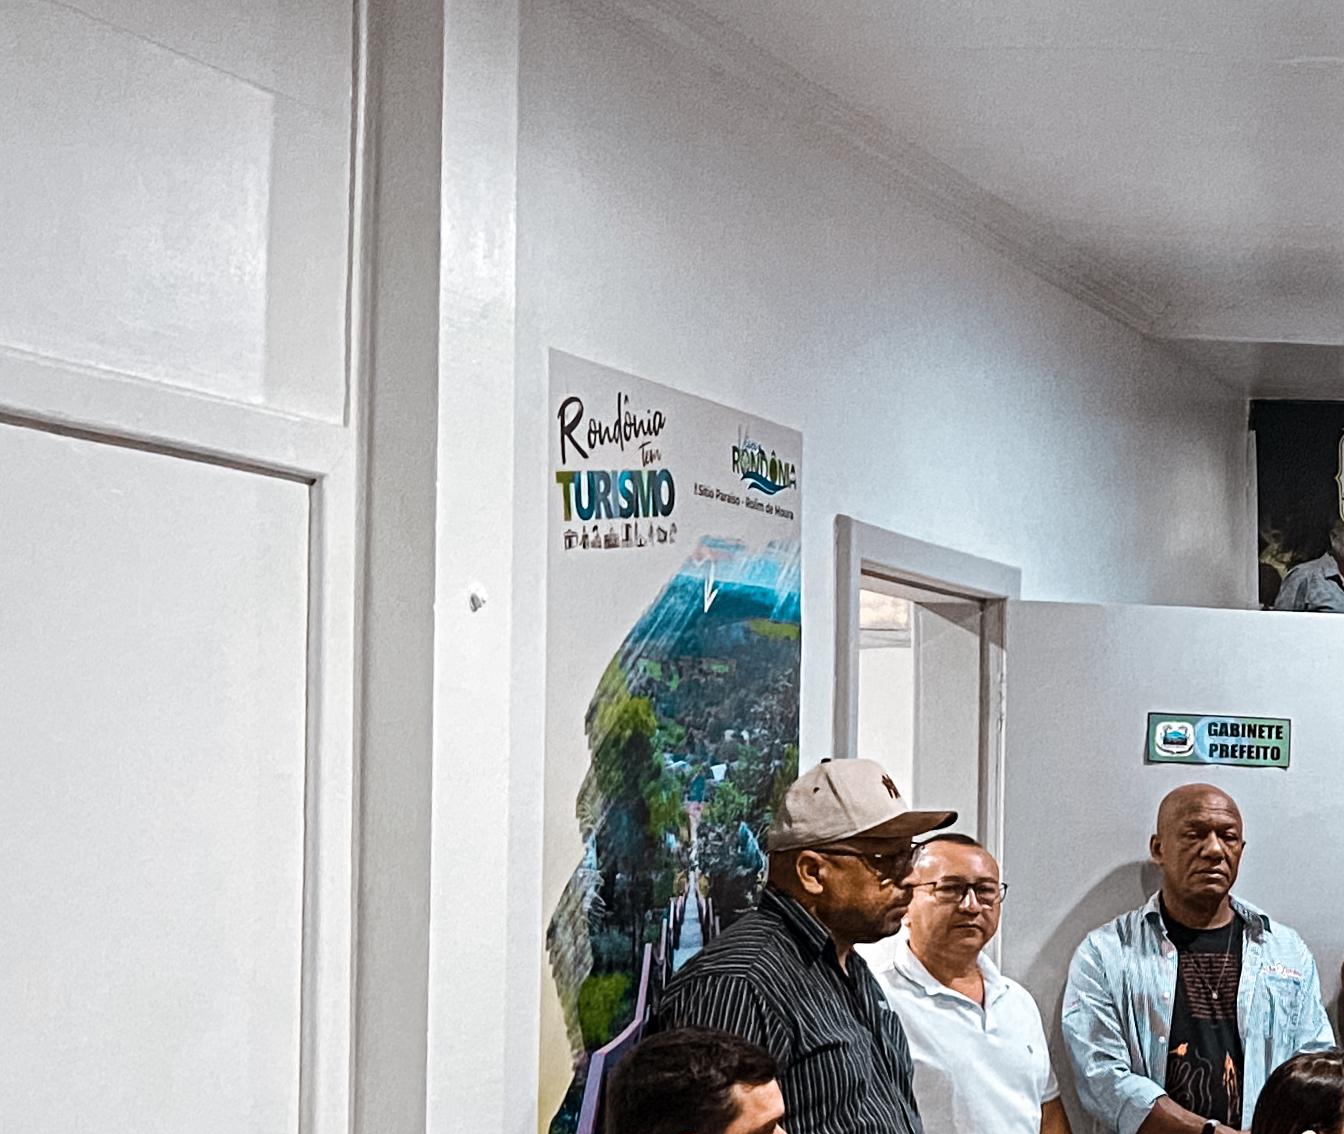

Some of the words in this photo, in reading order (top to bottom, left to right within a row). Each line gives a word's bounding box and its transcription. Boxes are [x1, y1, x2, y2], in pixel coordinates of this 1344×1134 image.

[557, 392, 666, 465] Rondônia
[556, 469, 676, 521] TURISMO
[1207, 722, 1284, 740] GABINETE
[1209, 743, 1281, 761] PREFEITO
